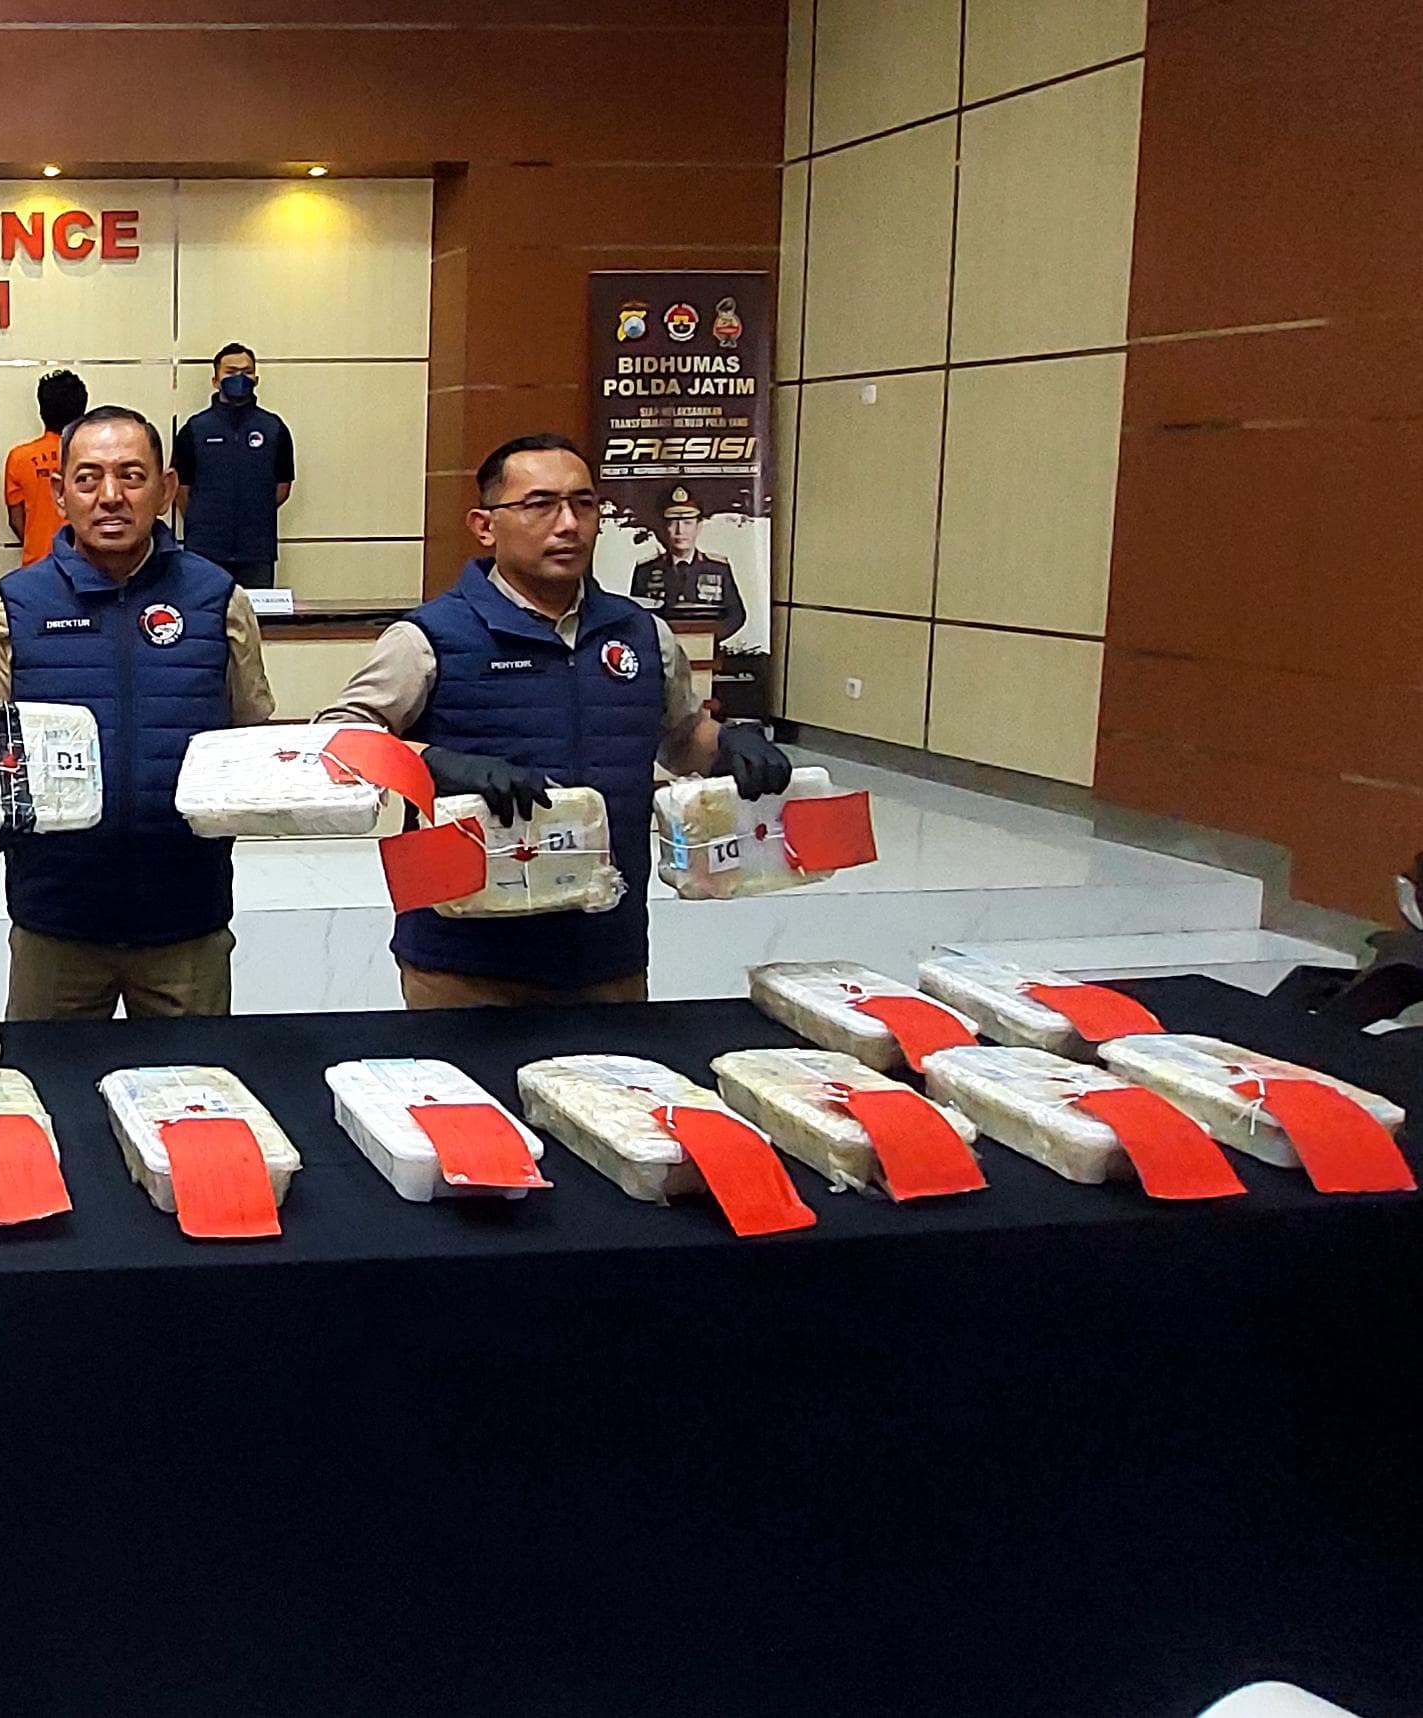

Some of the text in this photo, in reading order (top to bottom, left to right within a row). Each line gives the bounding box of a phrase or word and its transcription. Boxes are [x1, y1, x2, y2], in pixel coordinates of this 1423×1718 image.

[617, 355, 741, 374] BIDHUMAS
[603, 377, 755, 397] POLDA JATIM
[604, 437, 757, 461] PRESISI
[46, 618, 91, 629] DIREKTUR
[57, 751, 86, 771] D1
[548, 830, 578, 851] D1
[713, 839, 740, 863] D1
